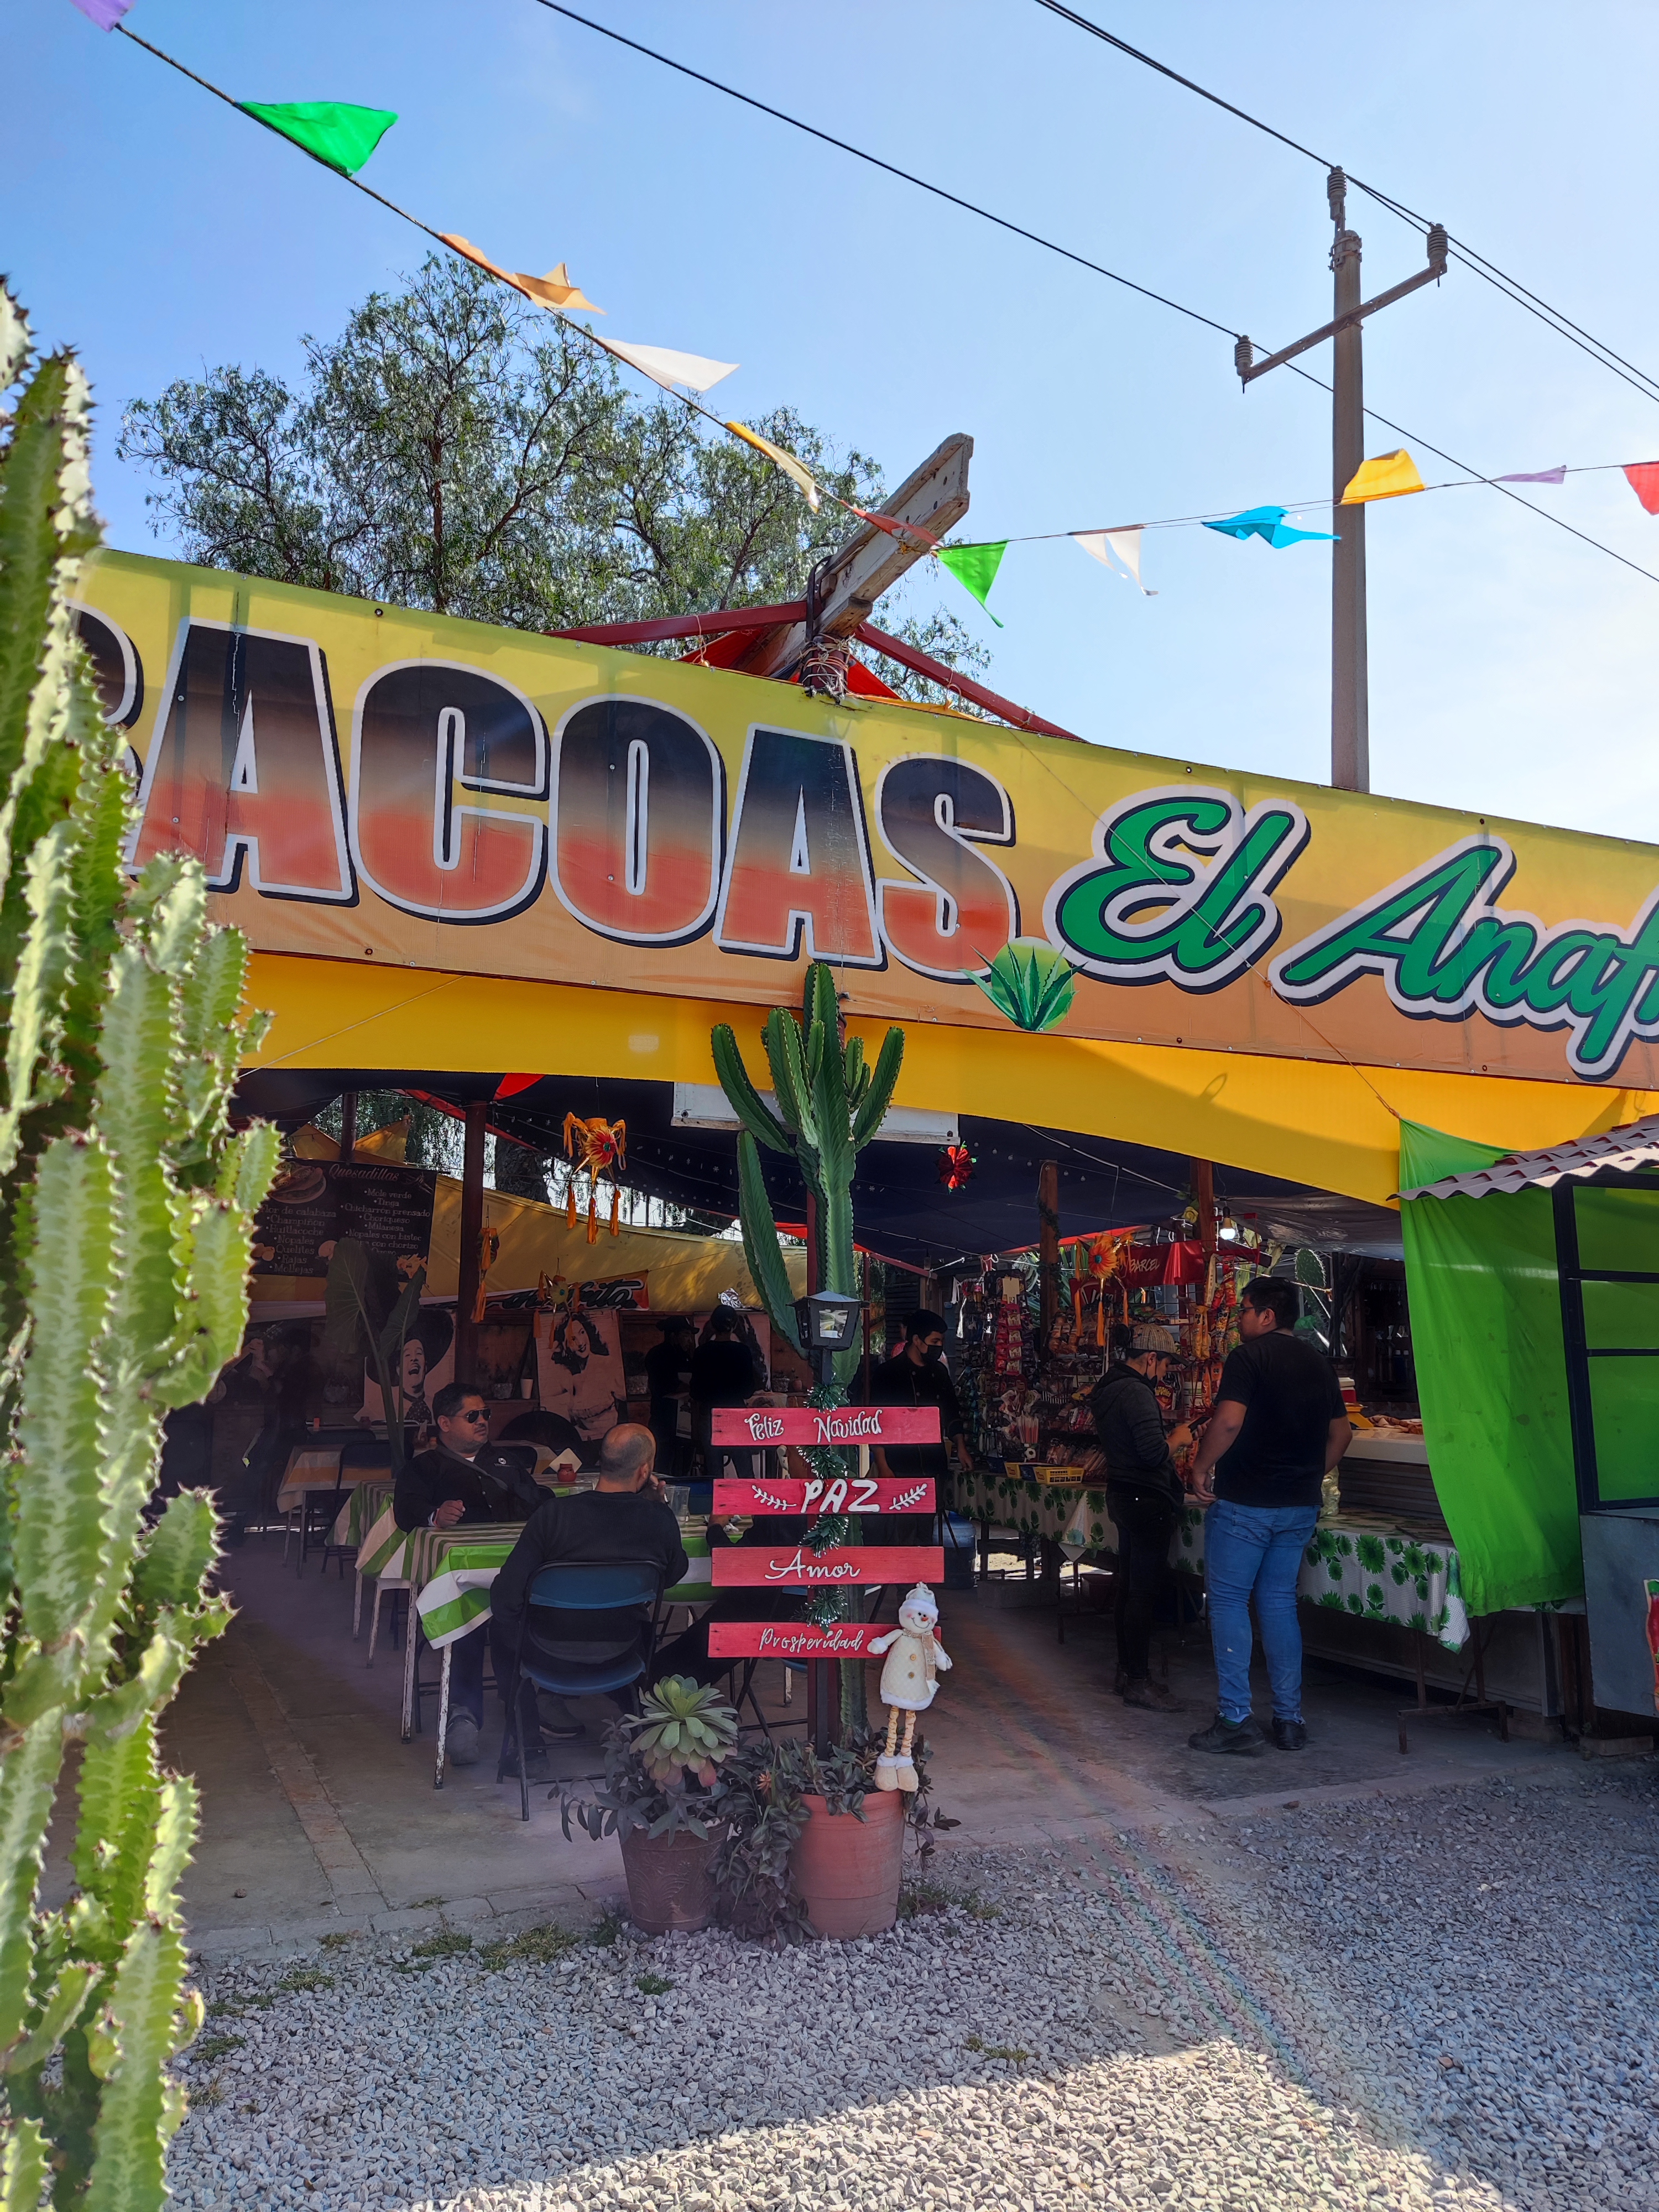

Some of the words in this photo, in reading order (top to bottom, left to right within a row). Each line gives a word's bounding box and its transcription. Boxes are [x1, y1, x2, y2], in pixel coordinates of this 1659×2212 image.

[1043, 785, 1311, 994] El
[328, 1164, 399, 1182] Quesadillas
[367, 1188, 387, 1197] Mole
[377, 1198, 399, 1208] Tinga
[281, 1206, 293, 1214] de
[296, 1207, 337, 1217] calabaza
[363, 1213, 410, 1224] Choriqueso
[269, 1224, 324, 1235] Huitlacoche
[368, 1222, 404, 1232] Milanesa
[277, 1235, 315, 1246] Nopales
[348, 1229, 380, 1238] Nopales
[399, 1233, 422, 1241] bistec
[276, 1244, 315, 1255] Quelites
[388, 1241, 419, 1250] chorizo
[281, 1254, 307, 1265] Rajas
[274, 1263, 314, 1275] Mollejas
[1130, 1259, 1160, 1272] BARCEL
[744, 1413, 784, 1441] Feliz
[813, 1409, 883, 1443] Navidad
[800, 1478, 880, 1513] PAZ
[764, 1549, 860, 1579] Amor
[758, 1627, 864, 1653] Prosperidad
